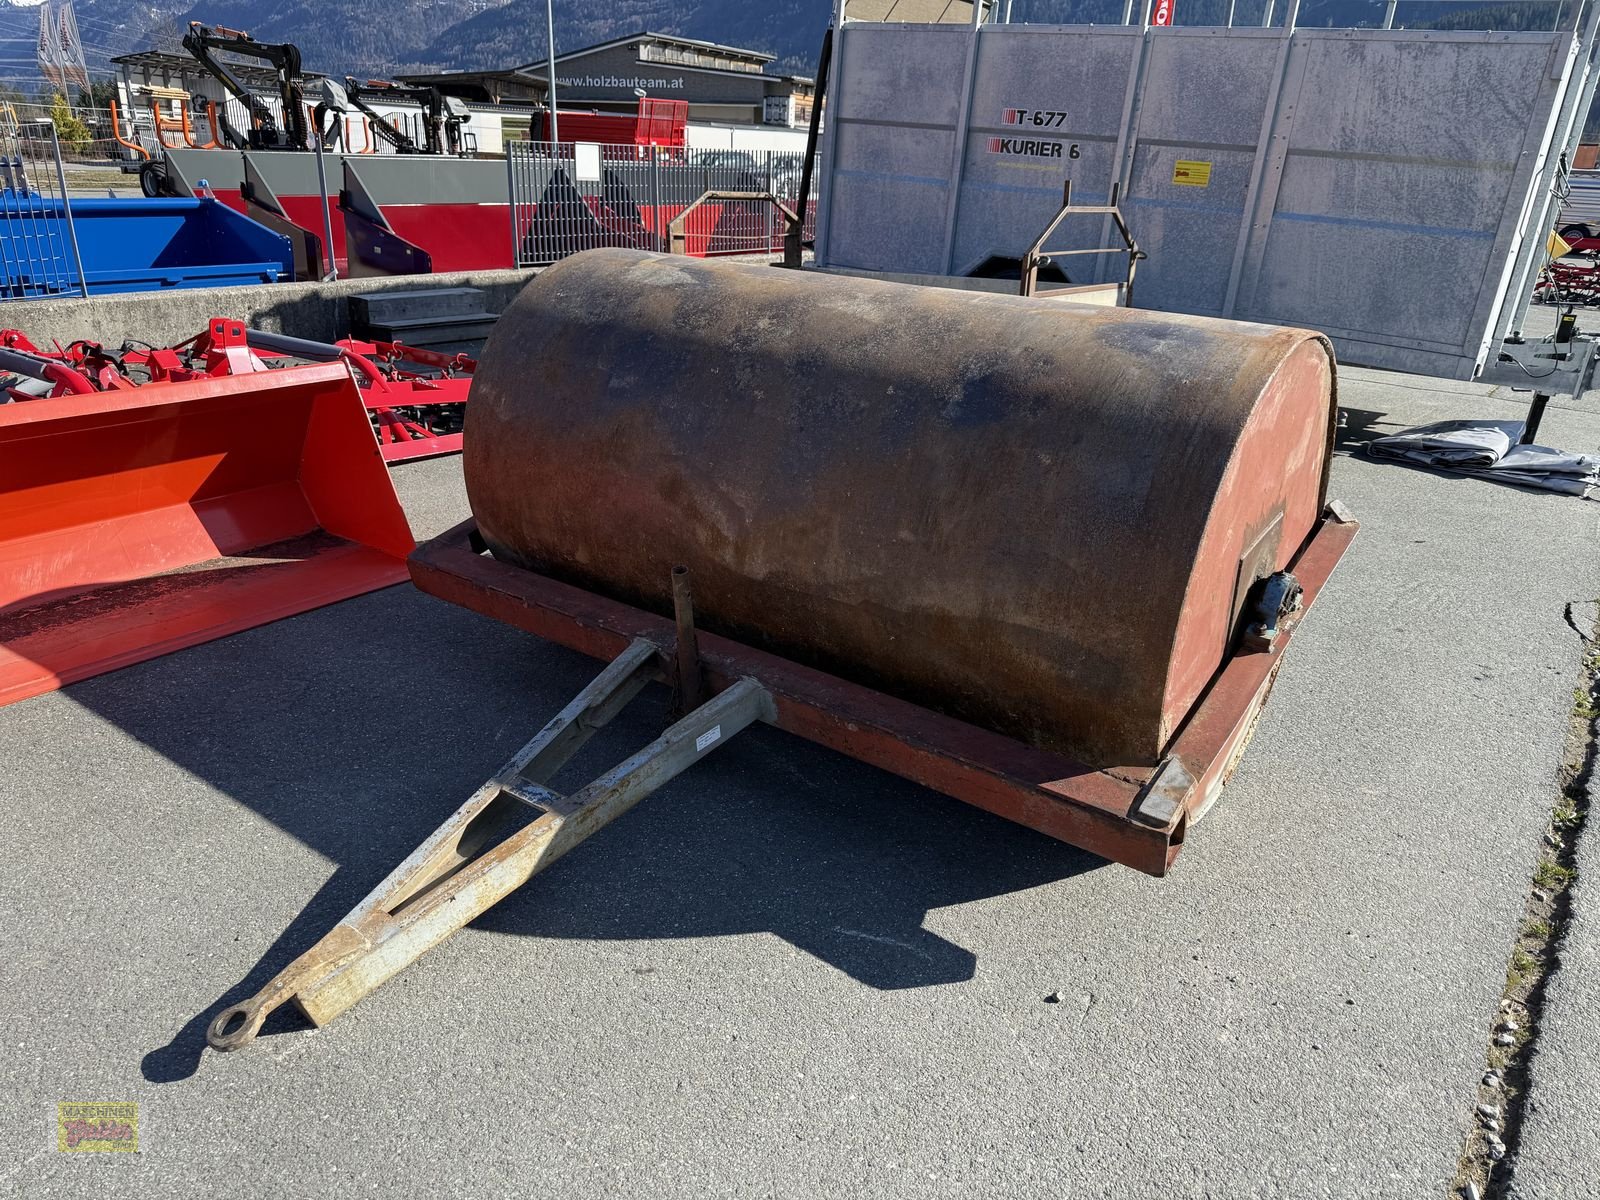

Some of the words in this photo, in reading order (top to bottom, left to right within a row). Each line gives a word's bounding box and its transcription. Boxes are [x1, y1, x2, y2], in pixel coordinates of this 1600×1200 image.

[1016, 109, 1068, 128] T-677
[1000, 138, 1063, 158] KURIER
[1069, 144, 1080, 160] 6
